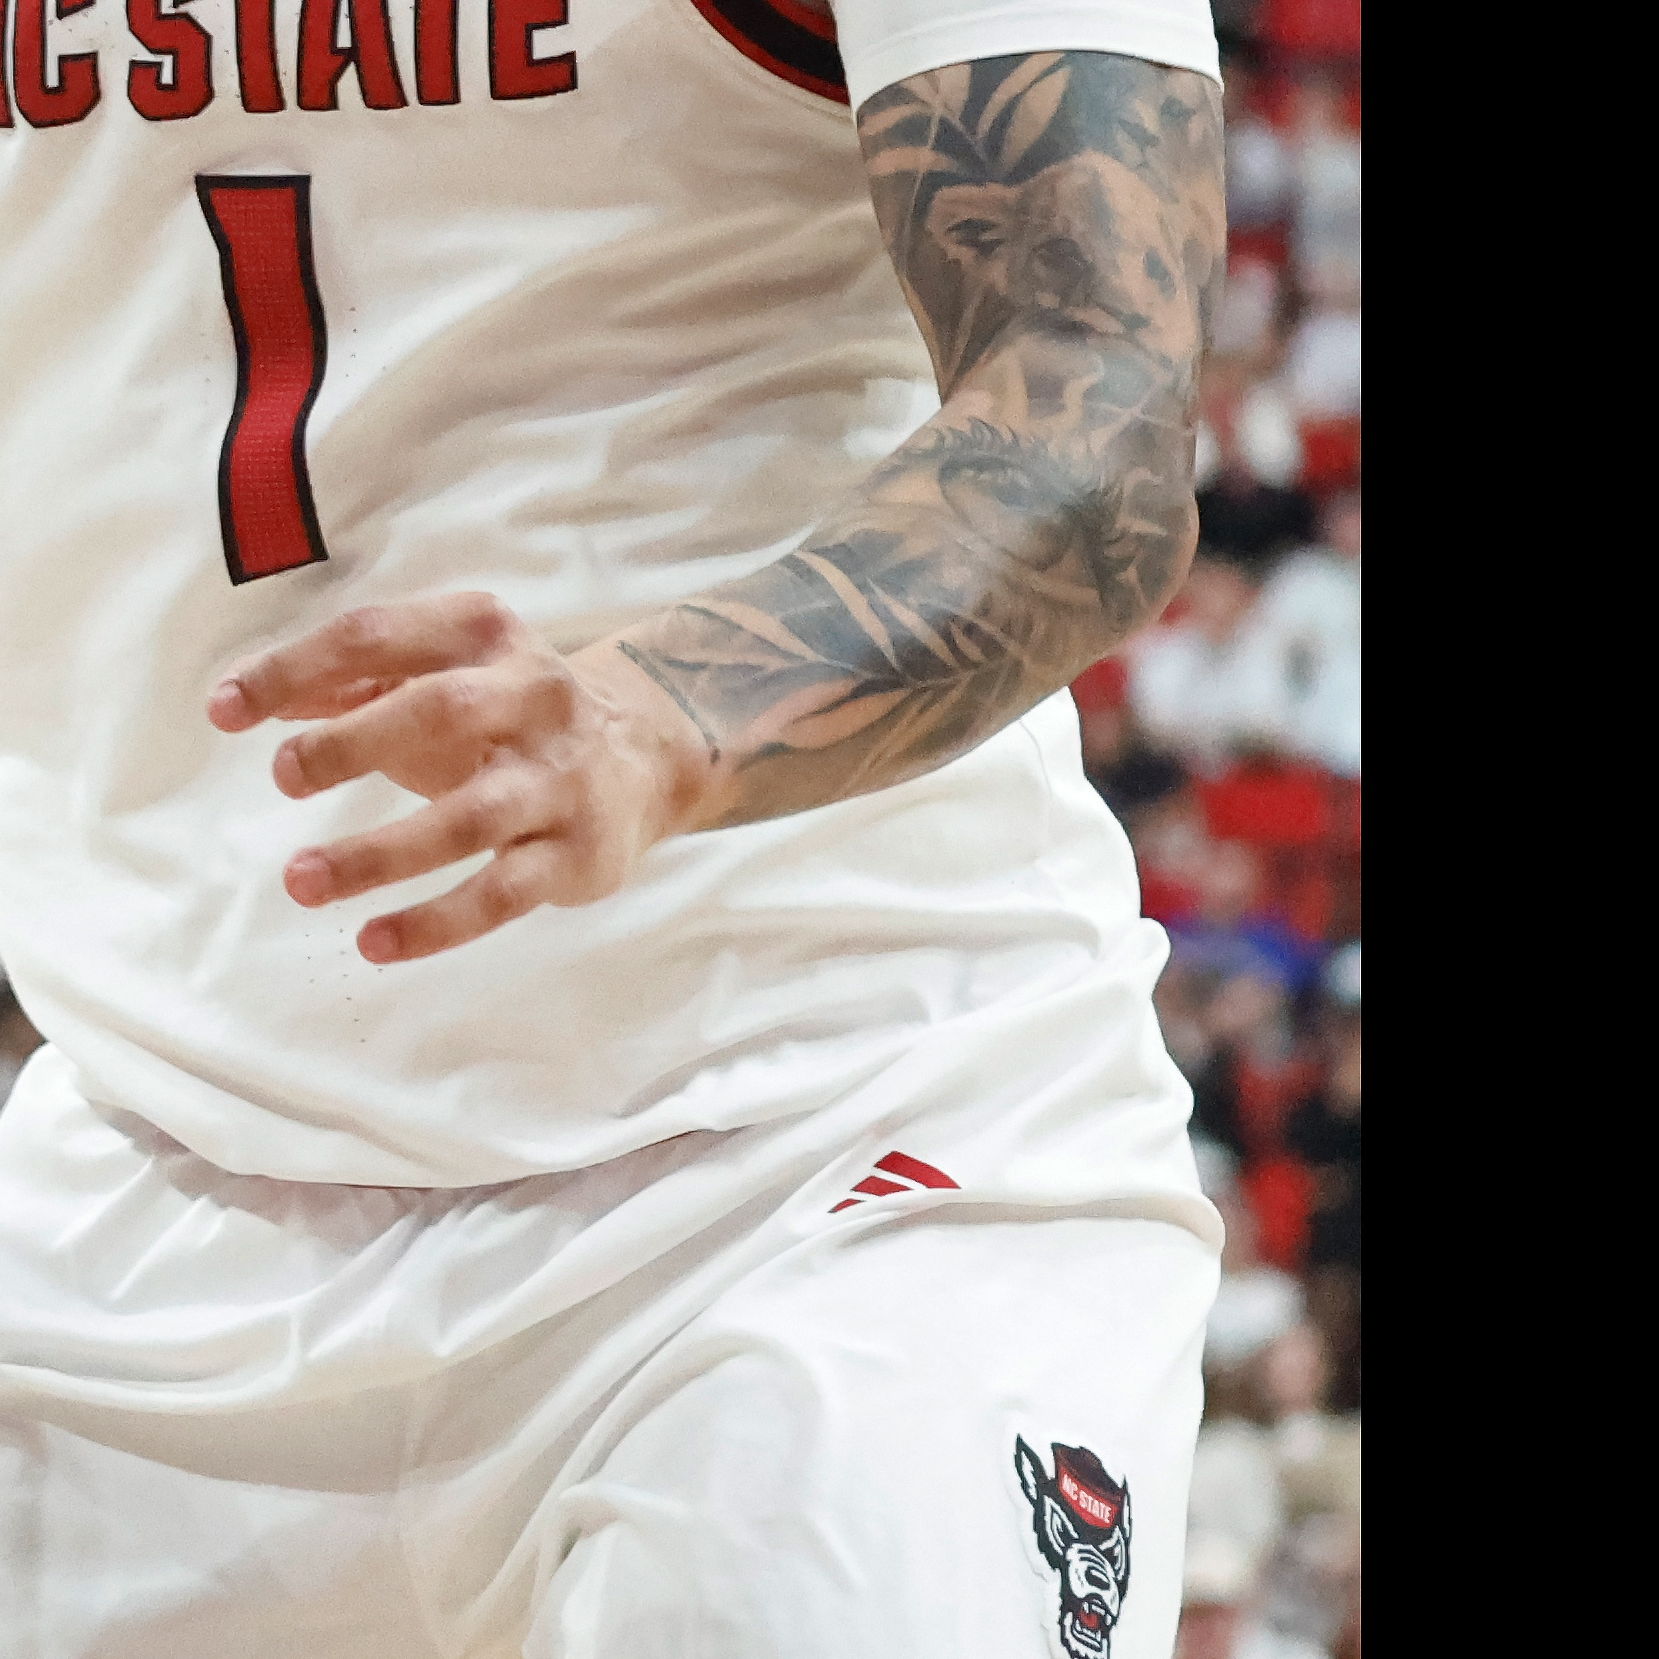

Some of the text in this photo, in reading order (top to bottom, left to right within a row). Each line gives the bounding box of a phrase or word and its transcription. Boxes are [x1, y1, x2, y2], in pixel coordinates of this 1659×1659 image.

[195, 174, 329, 587] 1
[1062, 1473, 1112, 1524] NC STATE
